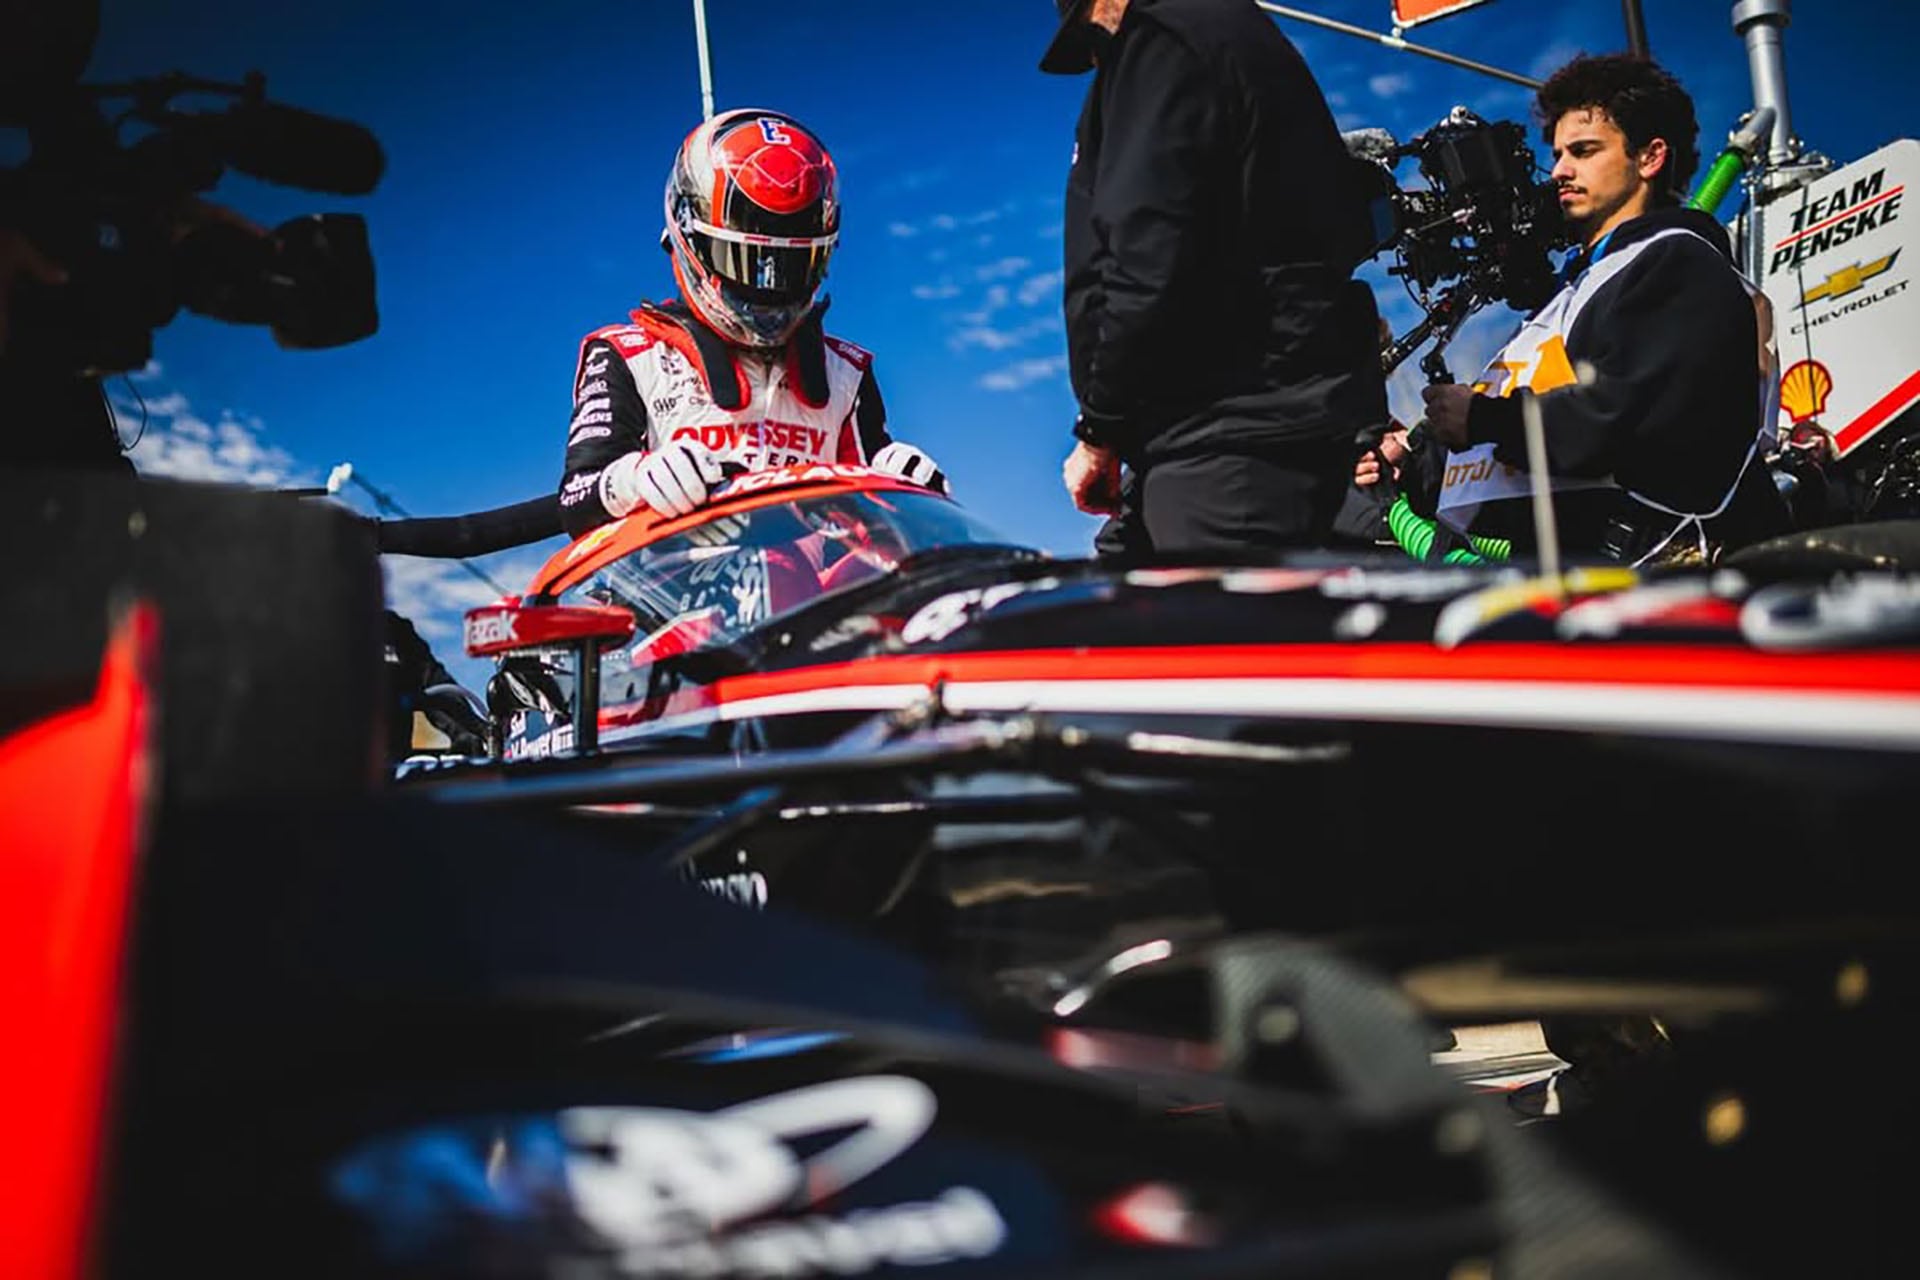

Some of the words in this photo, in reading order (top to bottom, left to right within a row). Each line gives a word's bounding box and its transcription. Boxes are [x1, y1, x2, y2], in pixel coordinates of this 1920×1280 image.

[1790, 168, 1885, 233] TEAM
[1769, 194, 1902, 275] PENSKE
[1790, 279, 1909, 335] CHEVROLET
